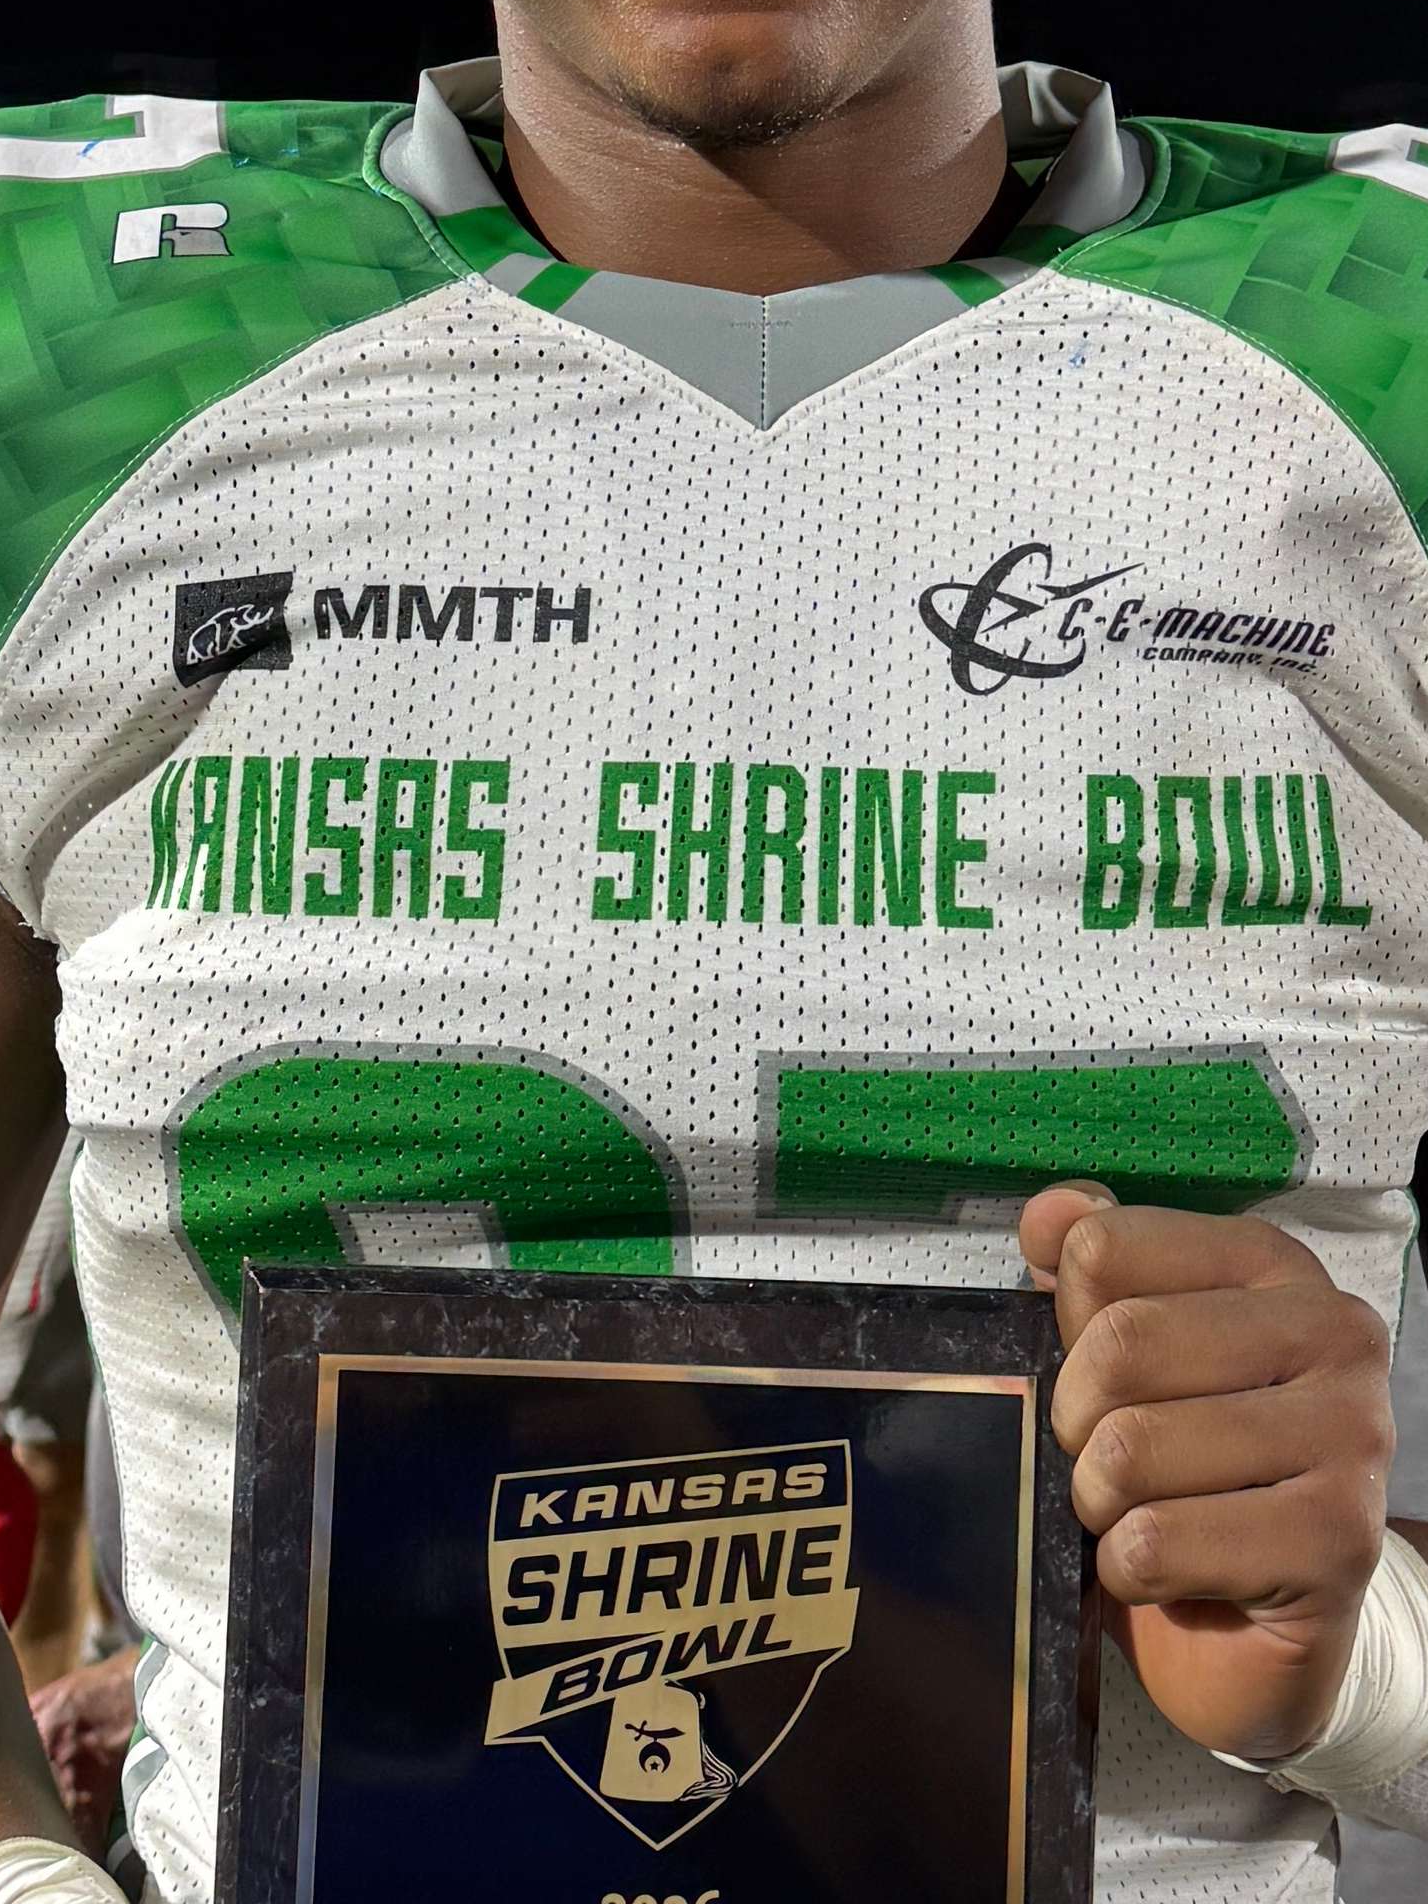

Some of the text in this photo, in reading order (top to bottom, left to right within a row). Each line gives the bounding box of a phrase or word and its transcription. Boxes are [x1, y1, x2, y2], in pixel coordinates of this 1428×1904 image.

[314, 585, 592, 643] MMTH
[145, 755, 1373, 931] KANSAS SHRINE BOWL
[519, 1463, 827, 1528] KANSAS
[502, 1524, 842, 1626] SHRINE
[539, 1613, 793, 1715] BOWL
